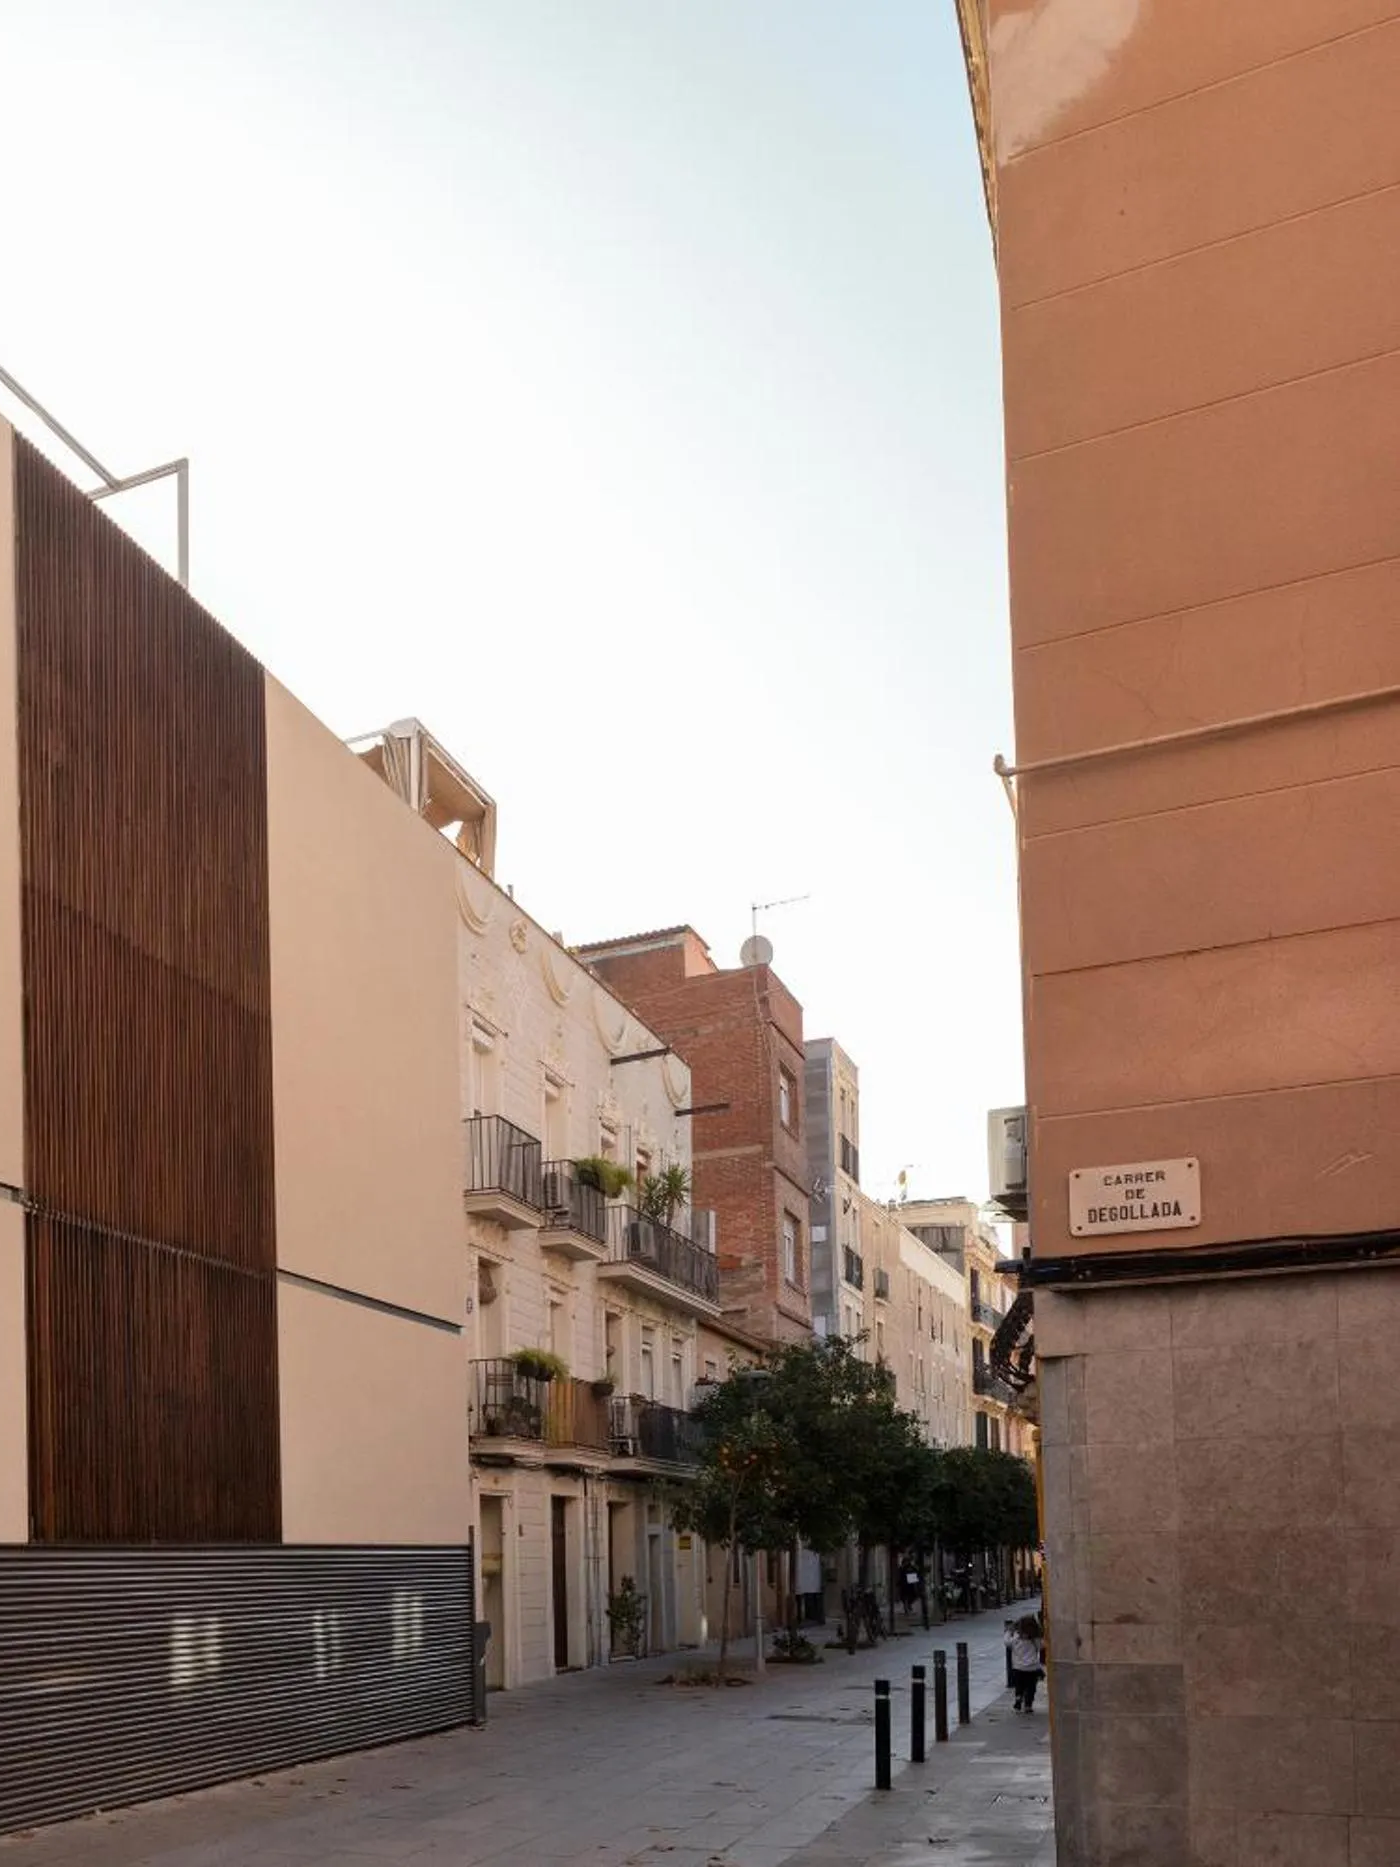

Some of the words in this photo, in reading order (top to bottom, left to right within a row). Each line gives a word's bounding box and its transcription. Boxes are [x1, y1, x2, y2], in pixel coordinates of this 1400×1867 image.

[1103, 1170, 1166, 1187] CARRER
[1124, 1187, 1146, 1201] DE
[1087, 1200, 1182, 1224] DEGOLLADA
